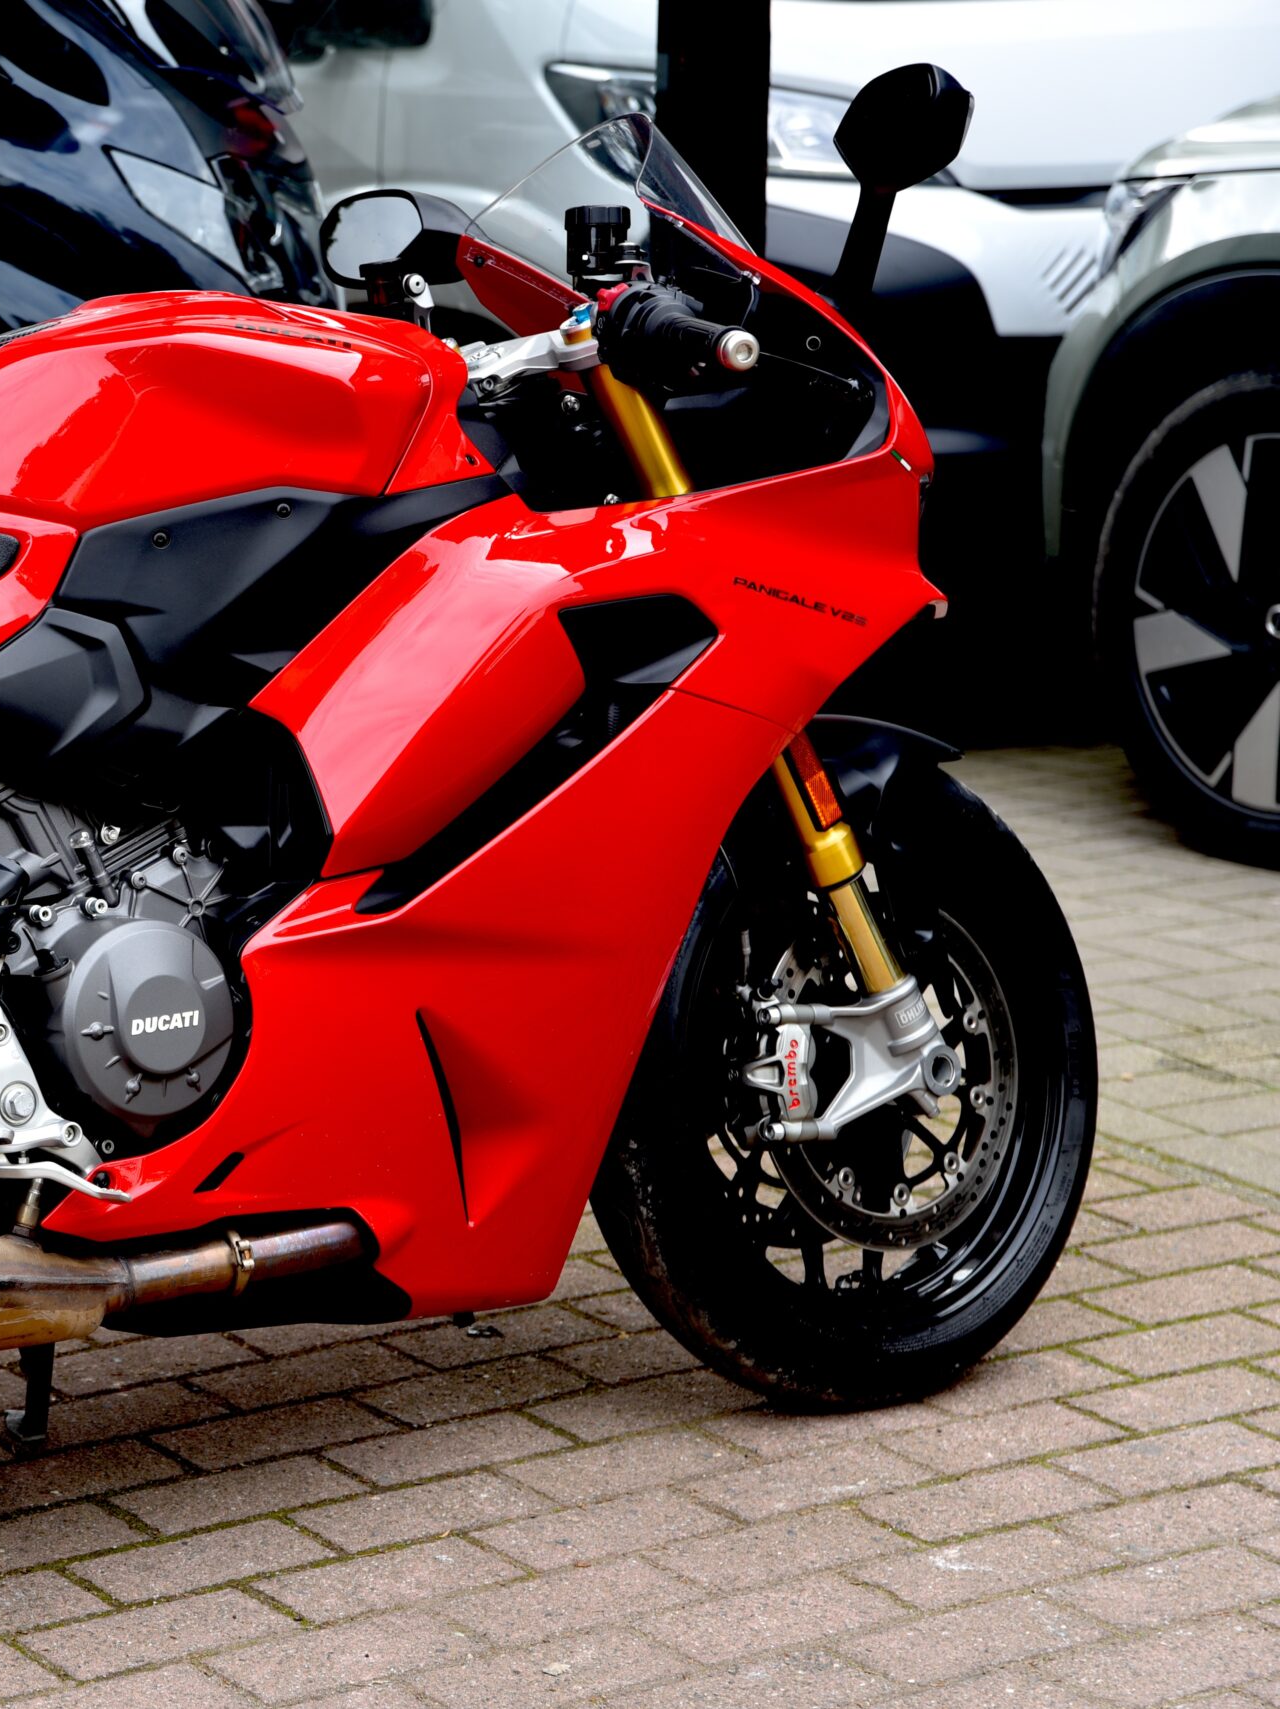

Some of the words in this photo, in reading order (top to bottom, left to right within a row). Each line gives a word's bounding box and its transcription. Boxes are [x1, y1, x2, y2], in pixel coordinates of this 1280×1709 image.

[733, 577, 827, 614] PANIGALE
[131, 1010, 199, 1036] DUCATI
[784, 1039, 800, 1111] brembo
